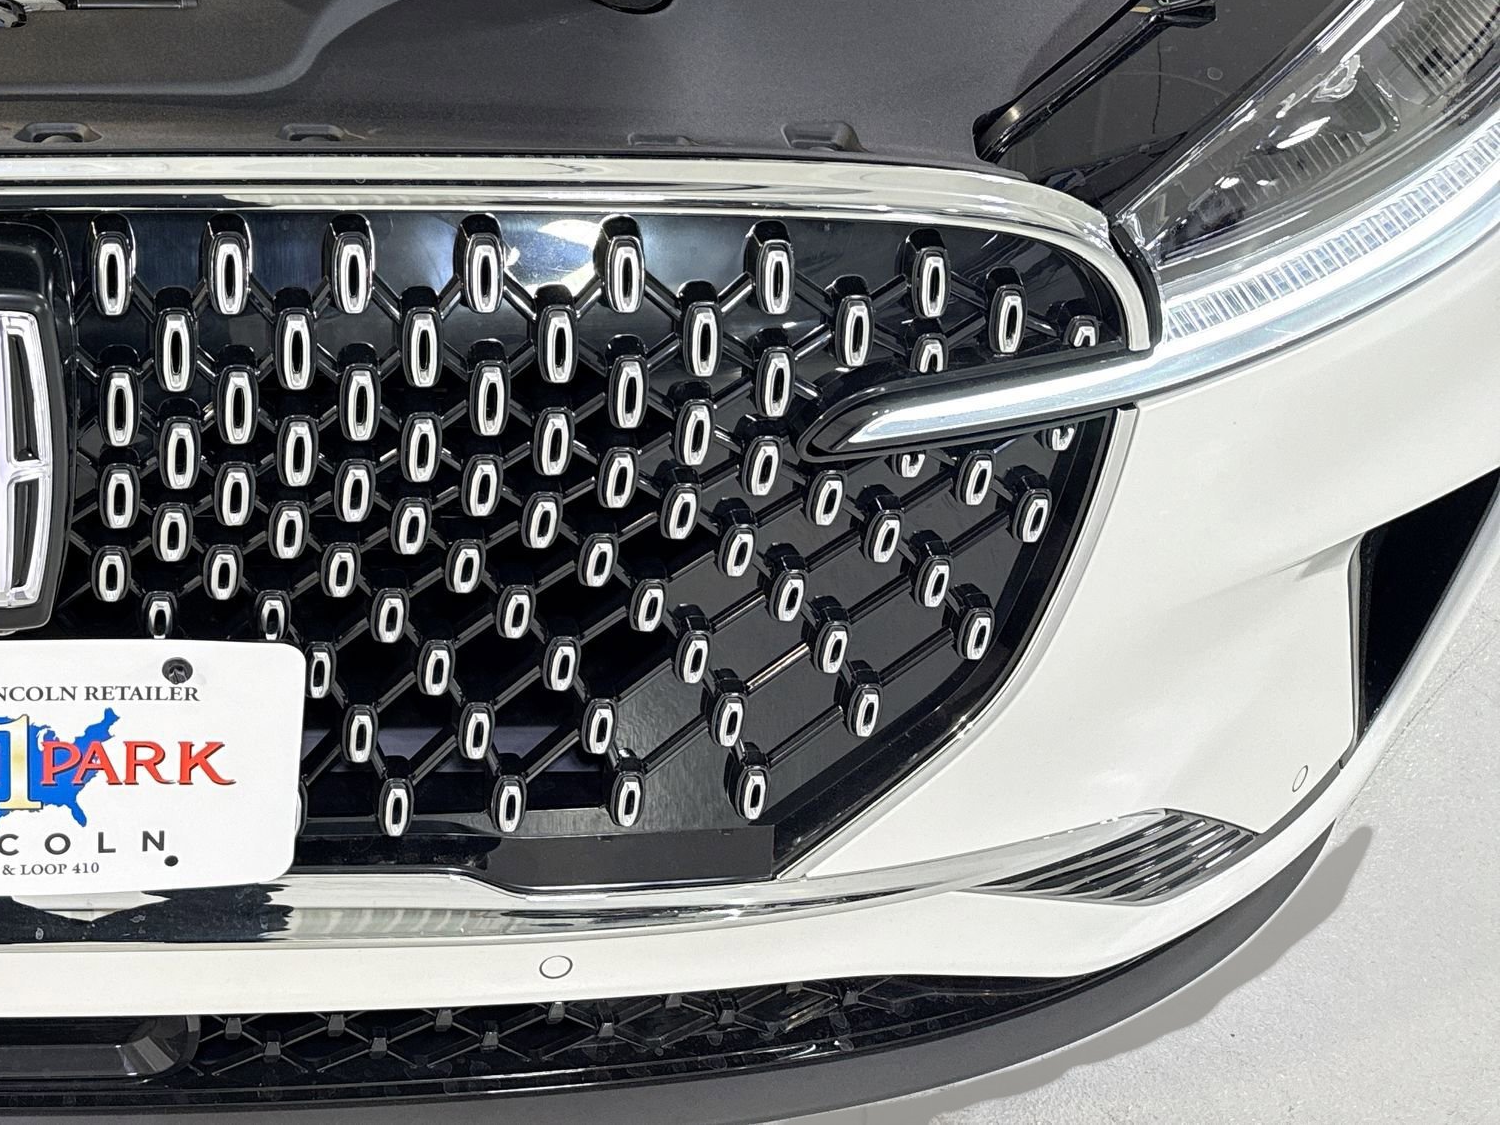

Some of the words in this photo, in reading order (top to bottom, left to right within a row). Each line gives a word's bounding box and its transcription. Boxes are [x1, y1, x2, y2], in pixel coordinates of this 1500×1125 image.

[84, 686, 200, 702] RETAILER
[40, 740, 236, 786] PARK
[2, 864, 15, 876] &
[21, 863, 67, 876] LOOP
[72, 862, 100, 875] 410
